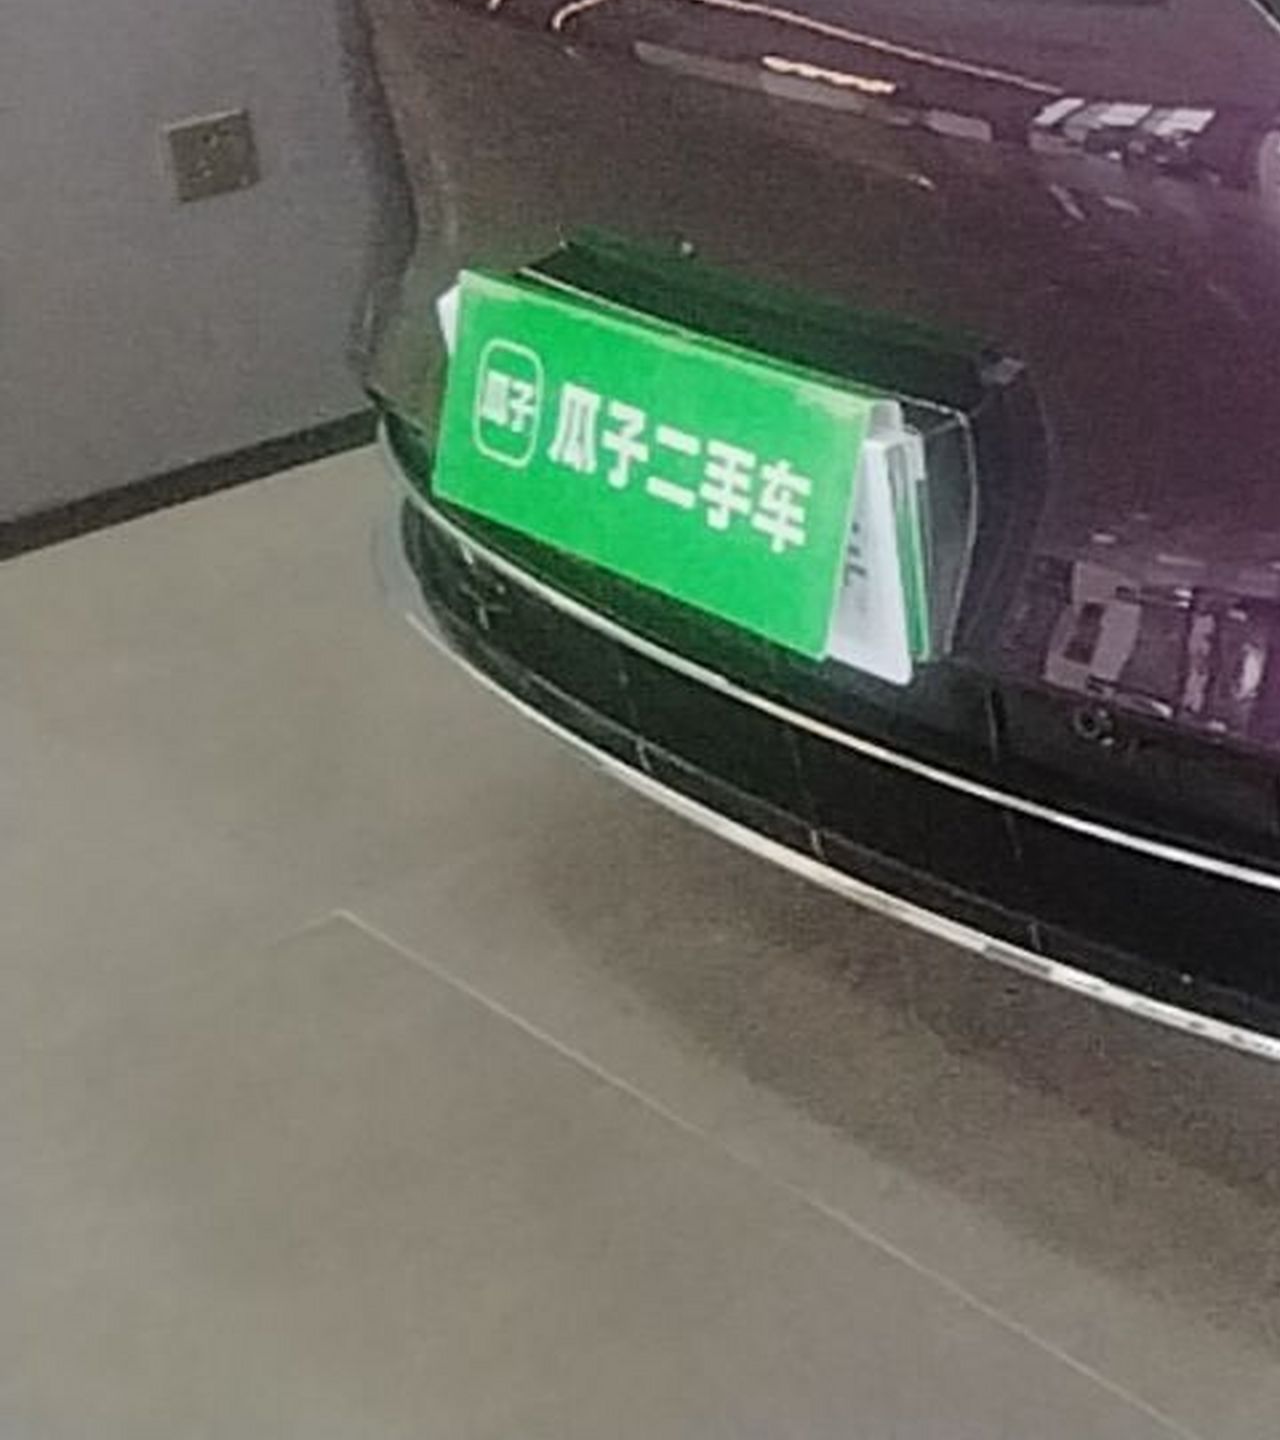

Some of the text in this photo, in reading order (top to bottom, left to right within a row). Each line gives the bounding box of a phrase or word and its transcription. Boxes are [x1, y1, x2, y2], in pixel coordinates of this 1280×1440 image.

[547, 382, 812, 554] 瓜子二手车
